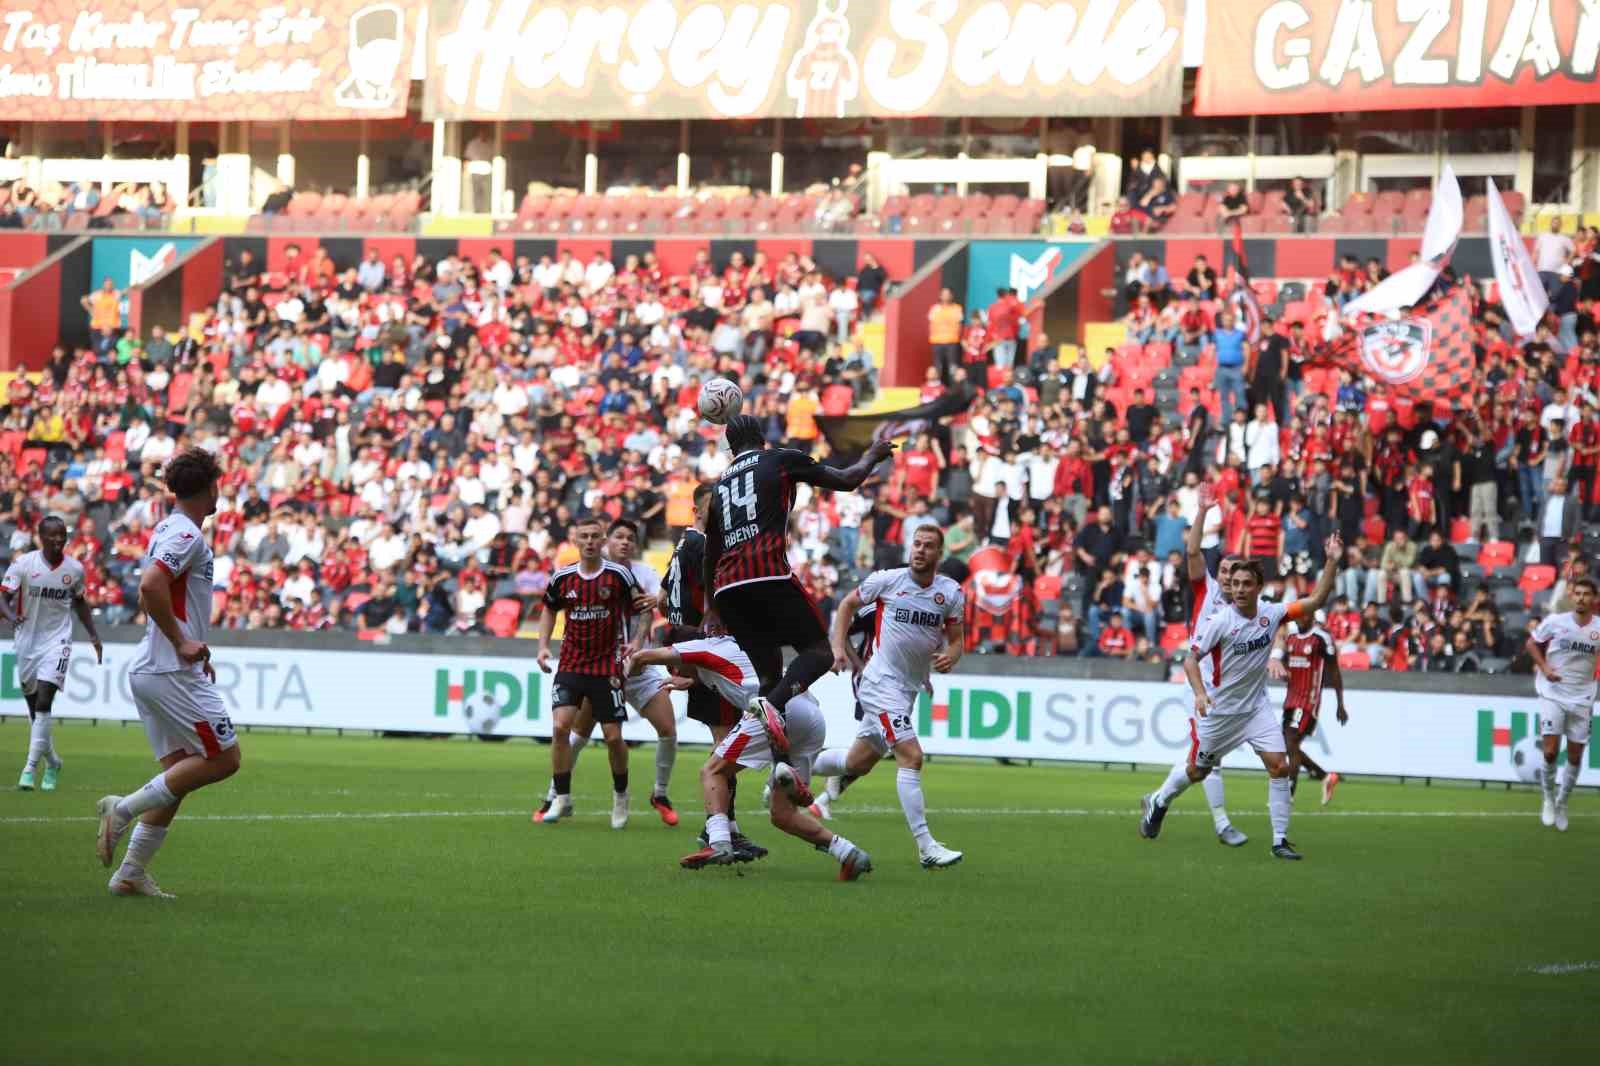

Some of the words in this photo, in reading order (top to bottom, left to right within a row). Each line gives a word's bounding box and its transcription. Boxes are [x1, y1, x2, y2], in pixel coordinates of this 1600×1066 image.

[718, 471, 757, 530] 14
[725, 523, 759, 548] ABENA
[910, 610, 942, 626] ARCA
[434, 668, 540, 720] HDI
[610, 688, 625, 708] 10
[918, 688, 1031, 741] HDI
